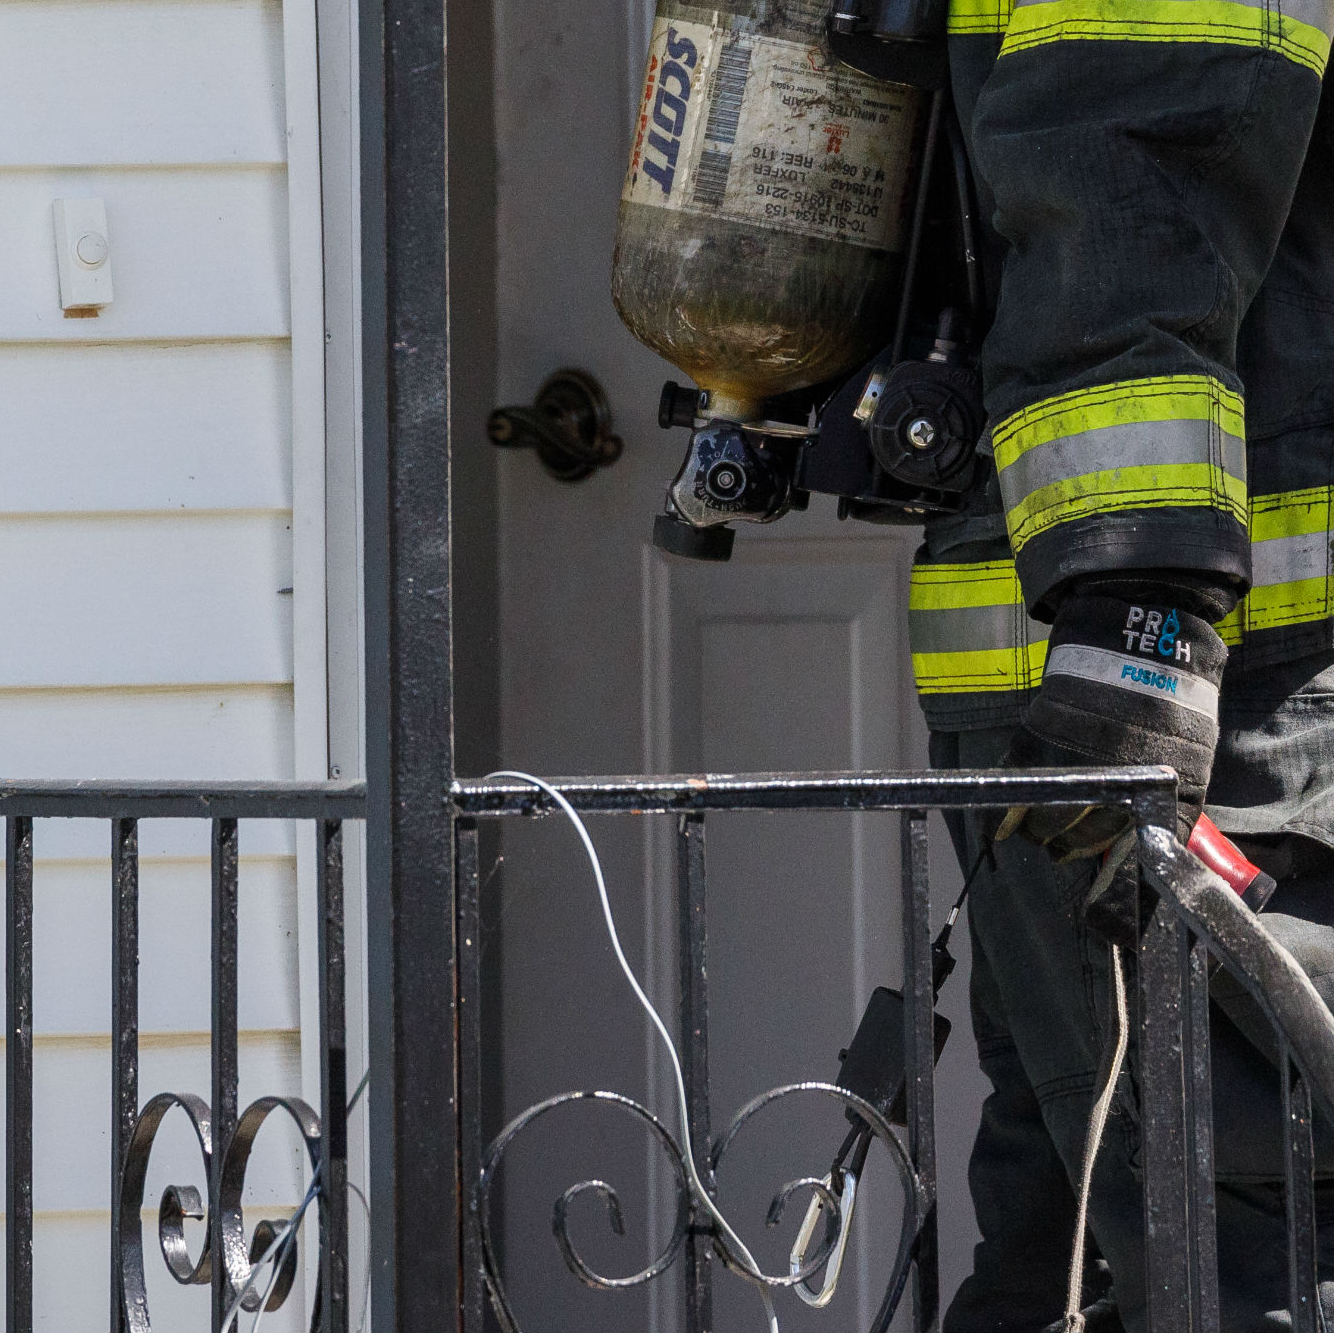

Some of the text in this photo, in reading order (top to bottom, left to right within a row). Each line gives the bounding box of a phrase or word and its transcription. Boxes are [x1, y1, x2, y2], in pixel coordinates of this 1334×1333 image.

[642, 27, 698, 195] SCOTT
[827, 103, 877, 123] MINUTES
[753, 163, 807, 183] LUXFER
[1126, 606, 1180, 638] PRO
[1122, 629, 1191, 663] TECH
[1121, 665, 1178, 695] FUSION
